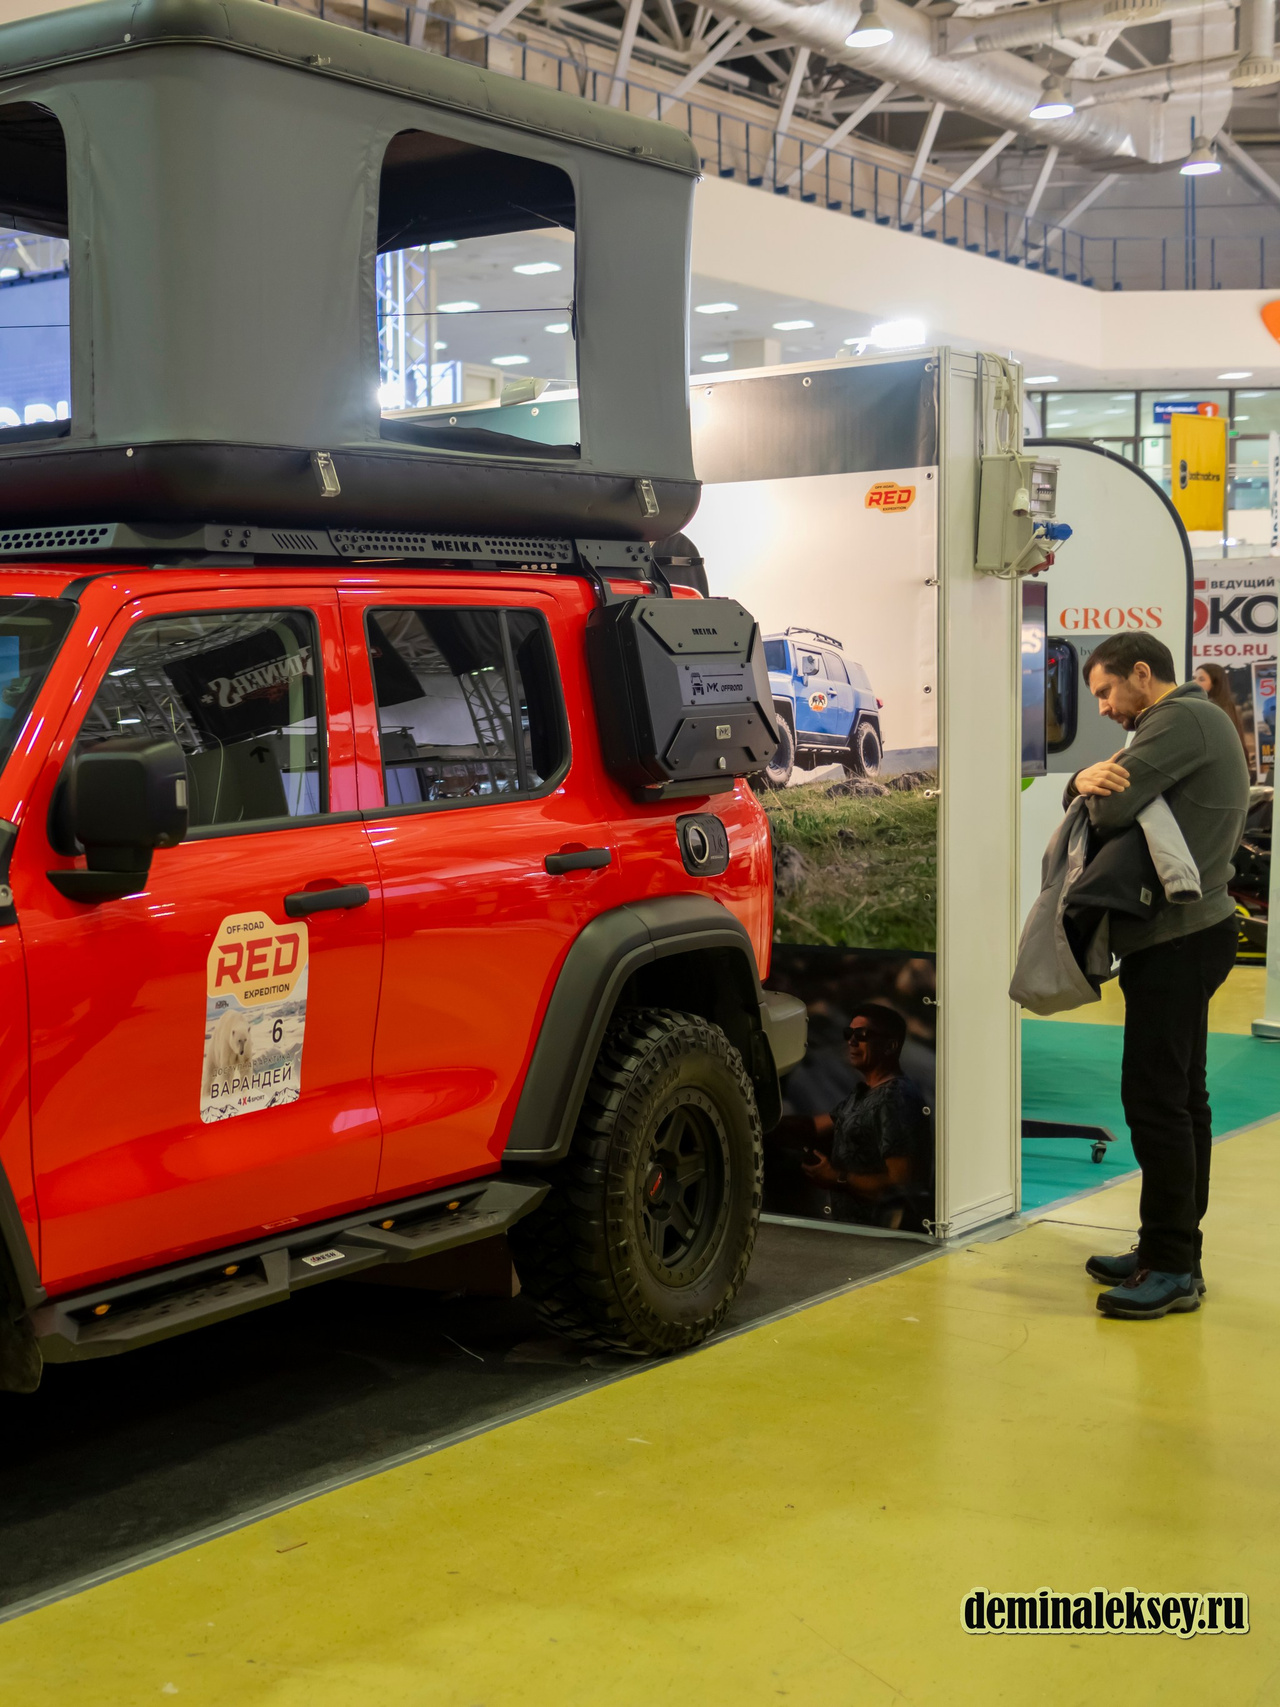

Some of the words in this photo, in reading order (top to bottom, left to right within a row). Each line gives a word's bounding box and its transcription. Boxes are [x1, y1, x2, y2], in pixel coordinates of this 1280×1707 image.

[868, 489, 912, 506] RED
[431, 540, 483, 552] MEIKA
[1211, 576, 1275, 590] ВЕДУЩИЙ
[1060, 607, 1162, 630] GROSS
[1193, 643, 1268, 657] LESO.RU
[226, 921, 265, 934] OFF-ROAD
[215, 933, 300, 988] RED
[244, 983, 290, 999] EXPEDITION
[272, 1018, 283, 1043] 6
[211, 1062, 292, 1099] ВАРАНДЕЙ
